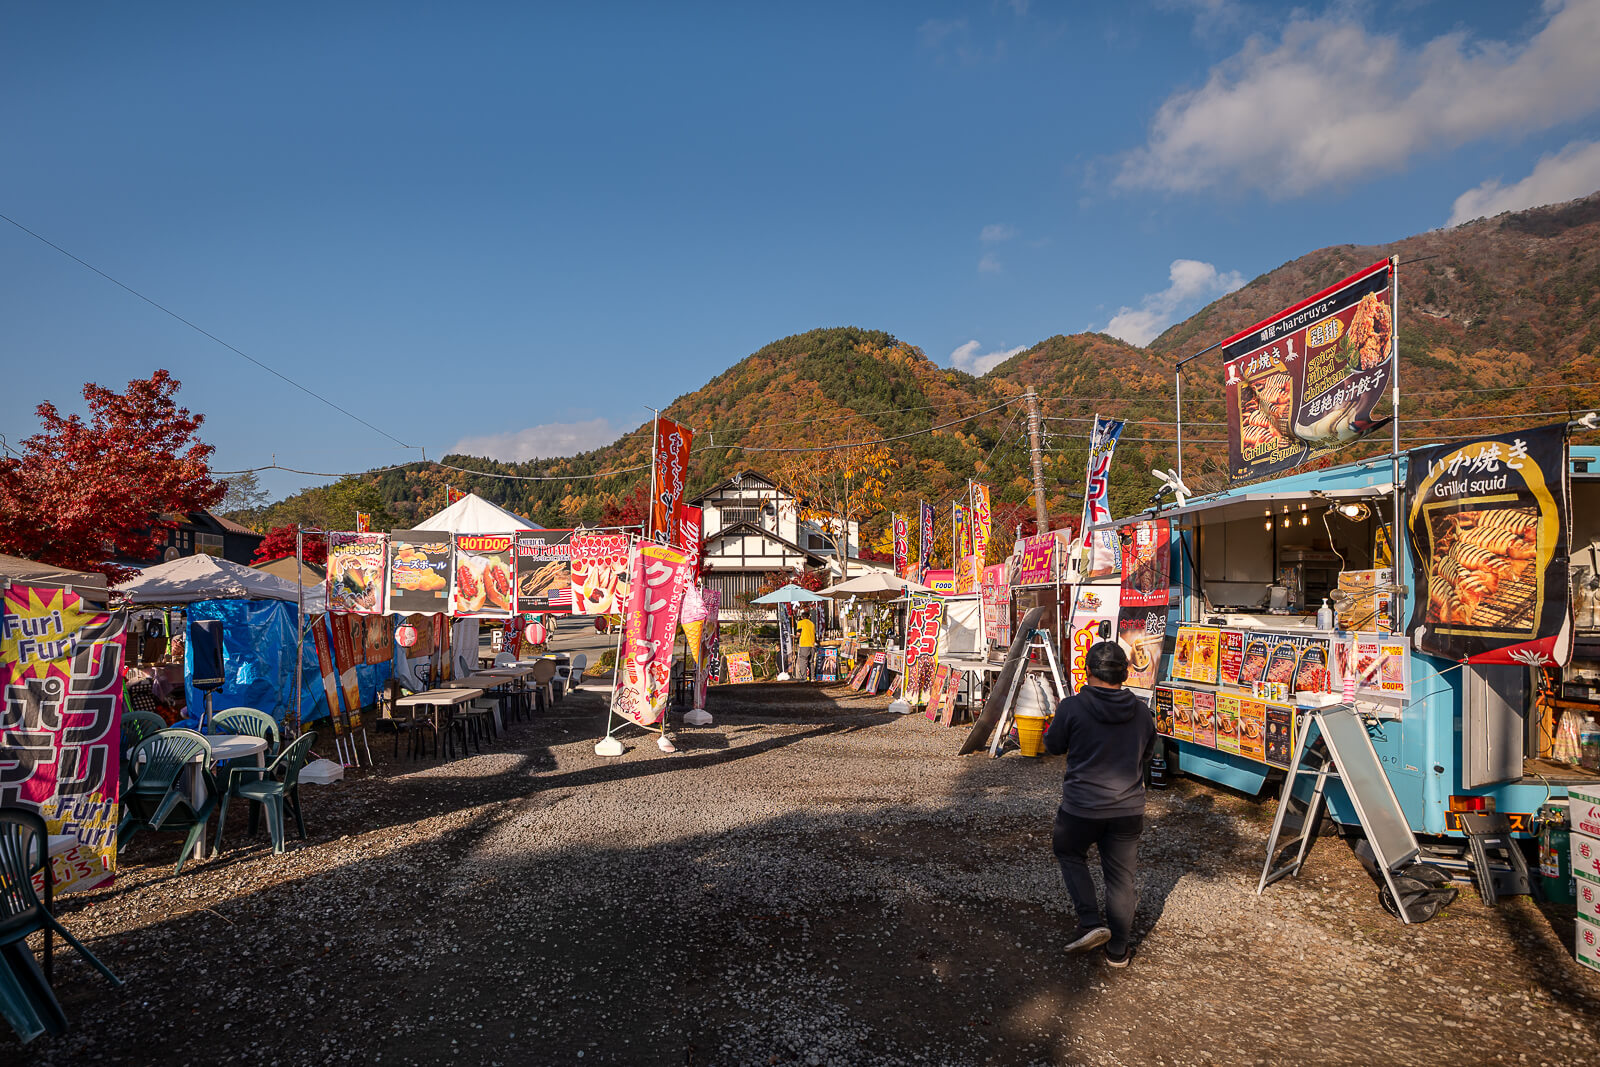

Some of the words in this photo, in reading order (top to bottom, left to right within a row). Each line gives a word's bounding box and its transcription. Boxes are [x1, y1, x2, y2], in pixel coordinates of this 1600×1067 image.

[1308, 344, 1337, 372] spicy
[1304, 369, 1345, 402] chicken
[1307, 368, 1385, 417] 超絶肉汁餃子
[1242, 438, 1279, 462] Grilled
[1428, 438, 1528, 480] いか焼き
[1470, 474, 1507, 495] squid
[333, 544, 382, 557] CHEESEDOG
[460, 537, 509, 550] HOTDOG
[519, 538, 545, 546] AMERICAN
[519, 545, 539, 556] LONG
[394, 559, 447, 572] チーズボール
[1022, 547, 1053, 572] クレープ
[635, 561, 674, 663] クレープ
[1146, 611, 1166, 635] 餃子
[3, 610, 63, 640] Furi
[906, 608, 925, 666] バナナ
[920, 602, 942, 656] チョコ
[19, 632, 78, 664] Furi
[1381, 682, 1404, 691] 600円
[56, 797, 113, 821] Furi
[61, 822, 117, 847] Furi
[1580, 843, 1591, 857] 岩
[1583, 887, 1592, 902] 岩
[1584, 930, 1594, 945] 岩
